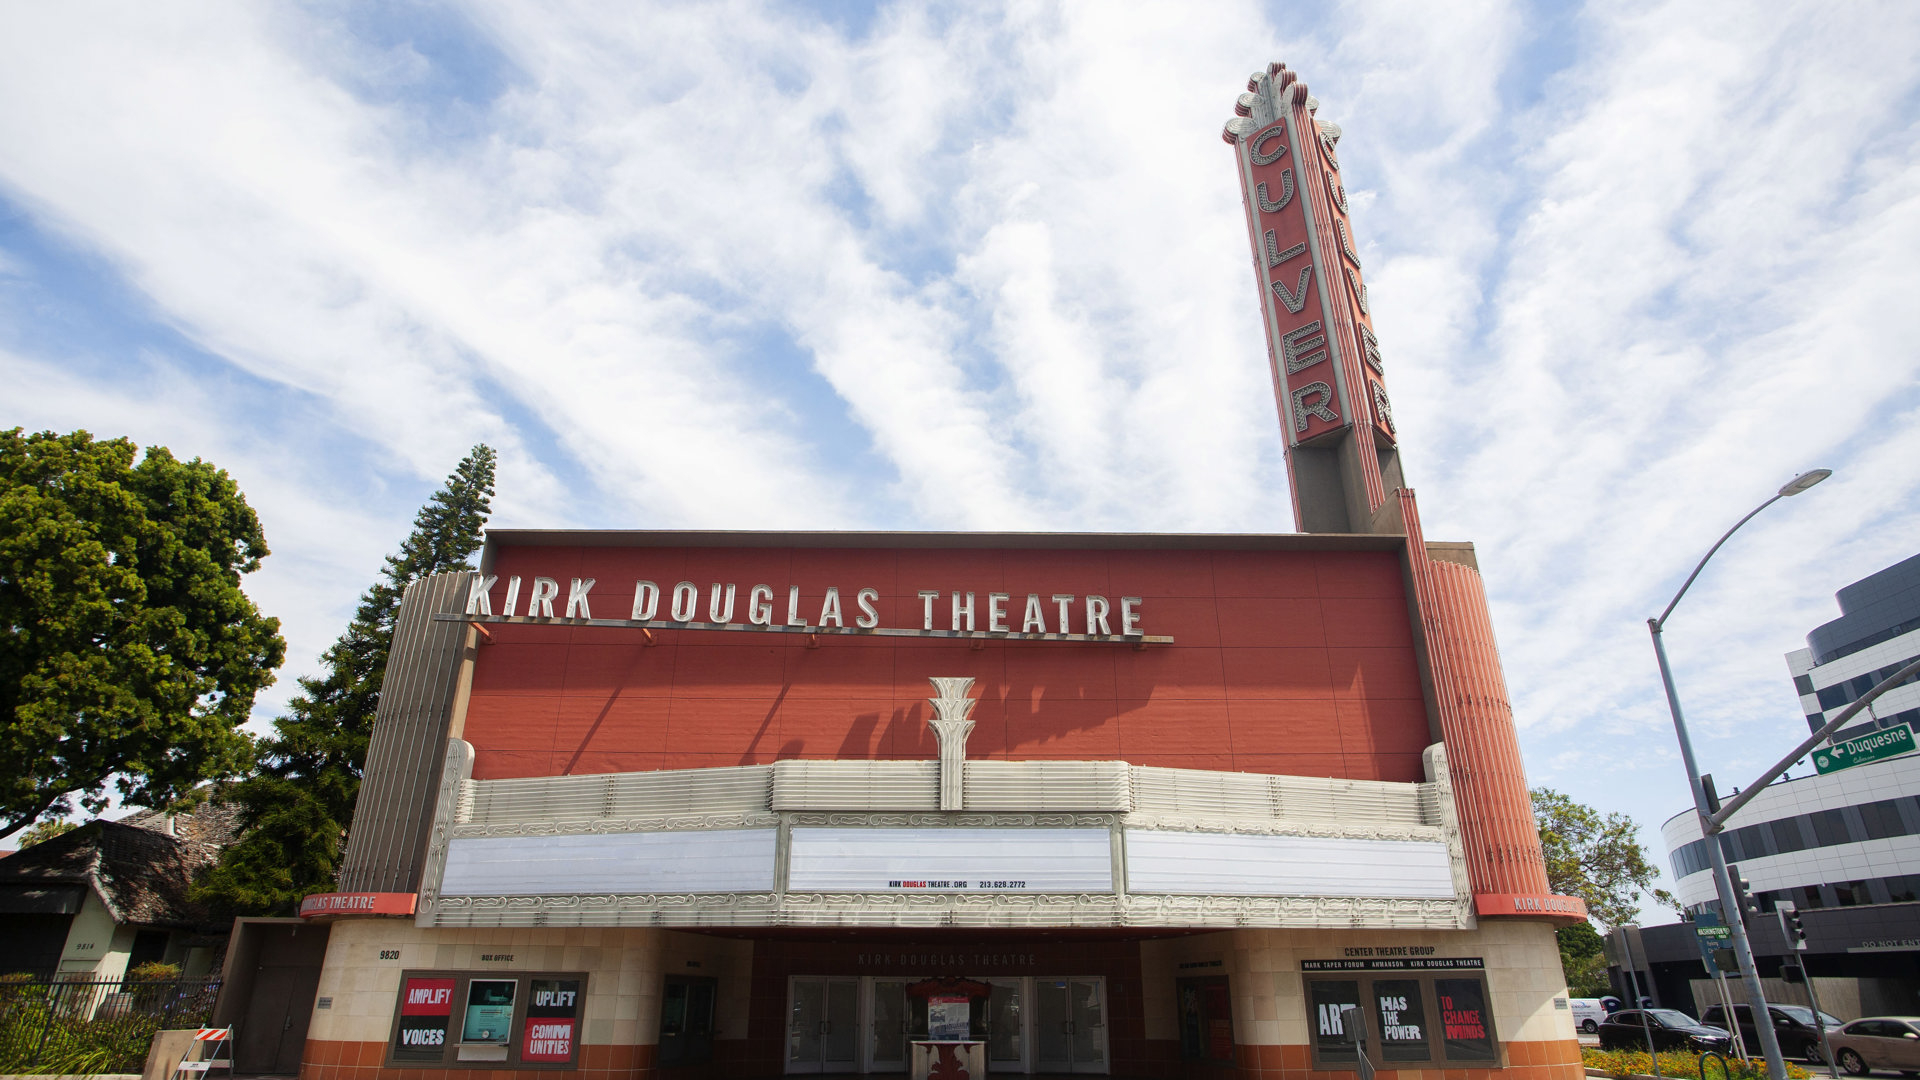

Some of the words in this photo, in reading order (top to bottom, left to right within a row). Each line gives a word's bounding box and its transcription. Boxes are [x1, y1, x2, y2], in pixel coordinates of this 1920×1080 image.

[1250, 126, 1338, 432] CULVER
[1319, 131, 1396, 435] CULVER
[466, 574, 596, 620] KIRK
[631, 580, 879, 629] DOUGLAS
[918, 591, 1144, 636] THEATRE
[1846, 729, 1907, 755] Duquesne
[889, 880, 901, 888] KIRK
[902, 880, 926, 888] DOUGLAS
[329, 896, 376, 909] THEATRE
[1514, 897, 1542, 911] KIRK
[380, 950, 400, 960] 9820
[858, 953, 891, 965] KIRK
[900, 953, 964, 965] DOUGLAS
[974, 953, 1036, 965] THEATRE
[1344, 947, 1373, 957] CENTER
[1376, 946, 1407, 956] THEATRE
[1410, 946, 1435, 956] GROUP
[408, 988, 452, 1004] AMPLIFY
[535, 991, 576, 1007] UPLIFT
[1380, 996, 1407, 1011] HAS
[1441, 996, 1452, 1010] TO
[1382, 1011, 1400, 1025] THE
[1443, 1010, 1481, 1025] CHANGE
[402, 1029, 445, 1045] VOICES
[532, 1024, 571, 1039] COMM
[1384, 1025, 1422, 1040] POWER
[1446, 1025, 1486, 1040] MINDS
[530, 1040, 569, 1055] UNITIES
